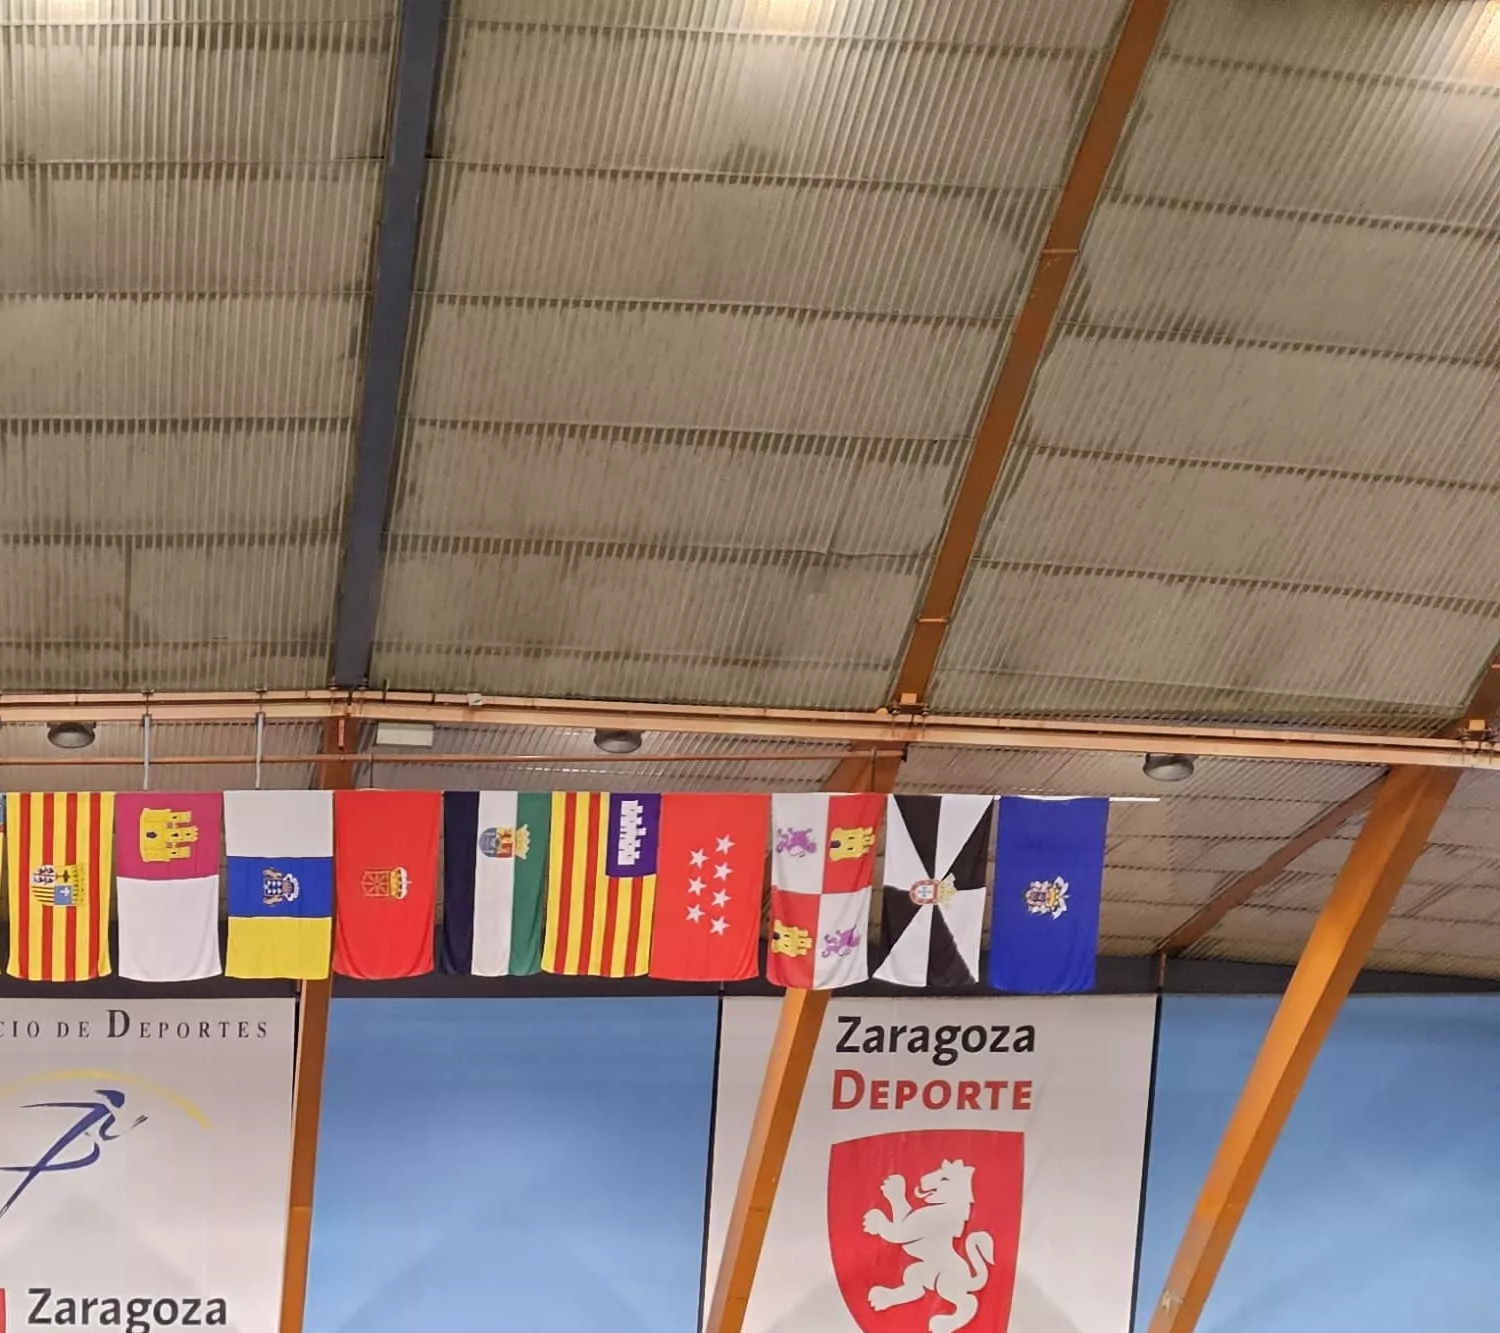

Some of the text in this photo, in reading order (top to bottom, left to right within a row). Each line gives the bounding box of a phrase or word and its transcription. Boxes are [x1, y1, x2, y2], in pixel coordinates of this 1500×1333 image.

[56, 1021, 90, 1038] DE
[106, 1009, 268, 1040] DEPORTES
[835, 1015, 1036, 1066] Zaragoza
[832, 1069, 1033, 1111] DEPORTE
